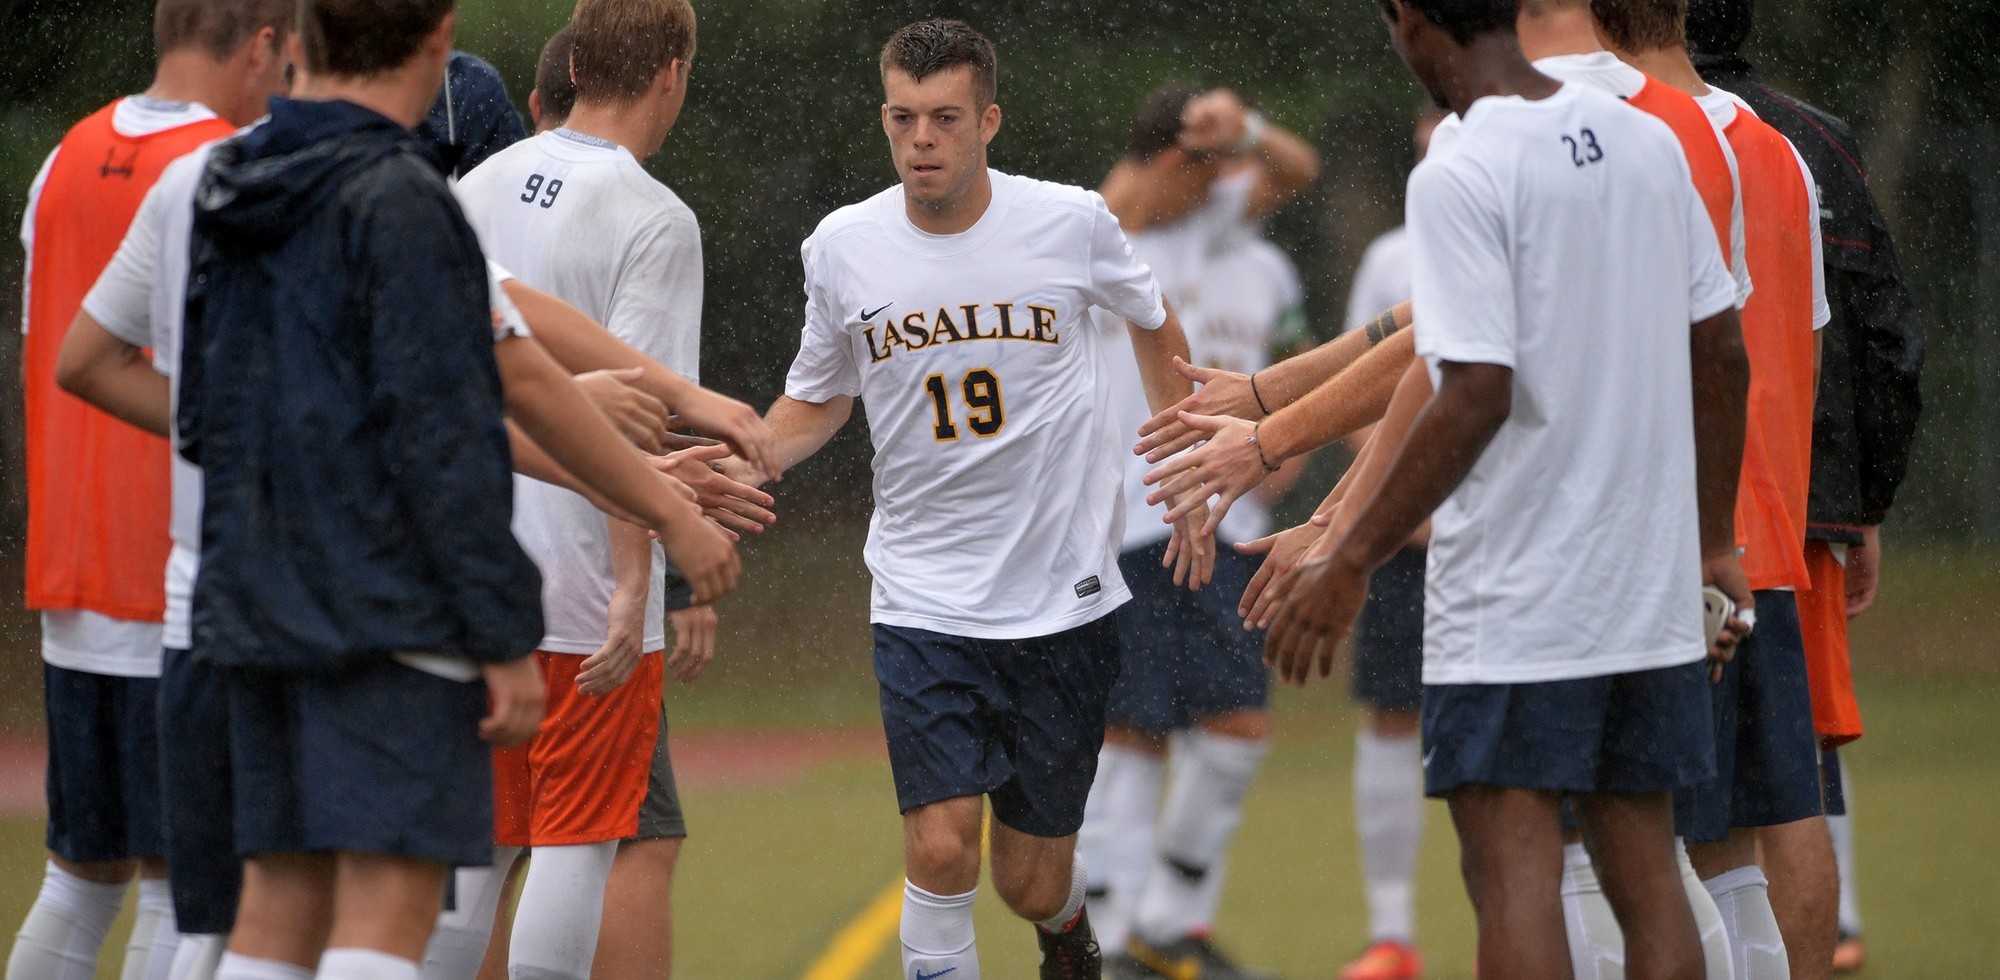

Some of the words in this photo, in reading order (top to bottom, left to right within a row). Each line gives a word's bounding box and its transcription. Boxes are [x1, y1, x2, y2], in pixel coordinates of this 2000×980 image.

[1561, 128, 1603, 167] 23
[520, 173, 563, 209] 99
[924, 366, 1006, 442] 19
